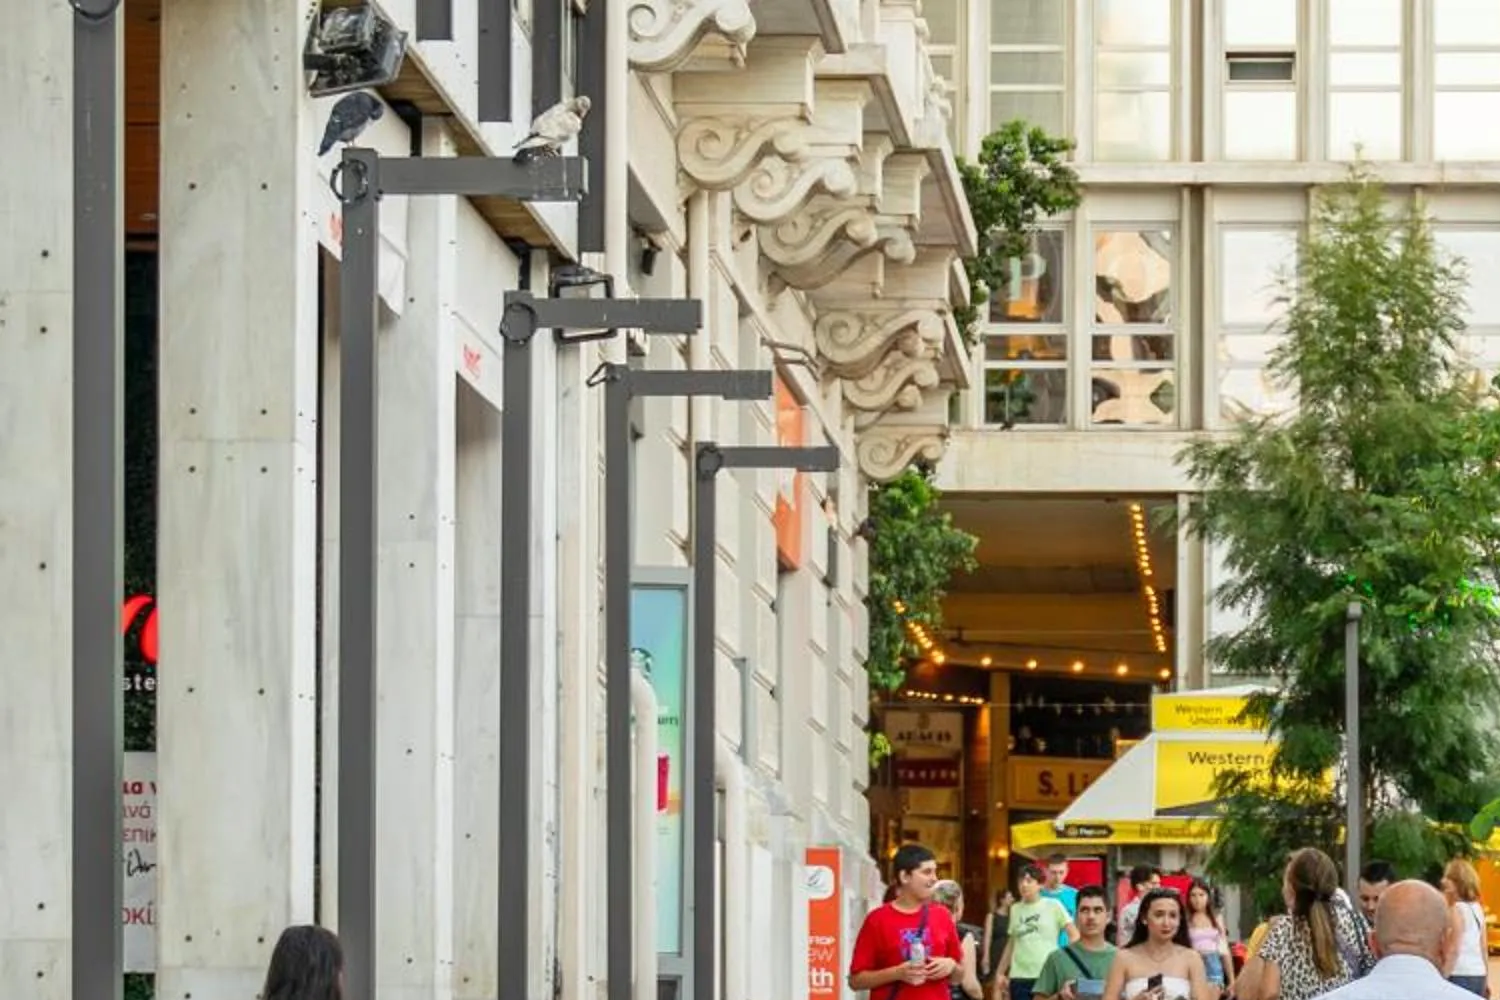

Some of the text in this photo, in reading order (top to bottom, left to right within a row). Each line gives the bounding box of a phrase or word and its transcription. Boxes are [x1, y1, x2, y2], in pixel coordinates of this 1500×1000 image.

[1175, 703, 1223, 715] Western
[1188, 751, 1265, 765] Western
[1038, 771, 1059, 797] S.
